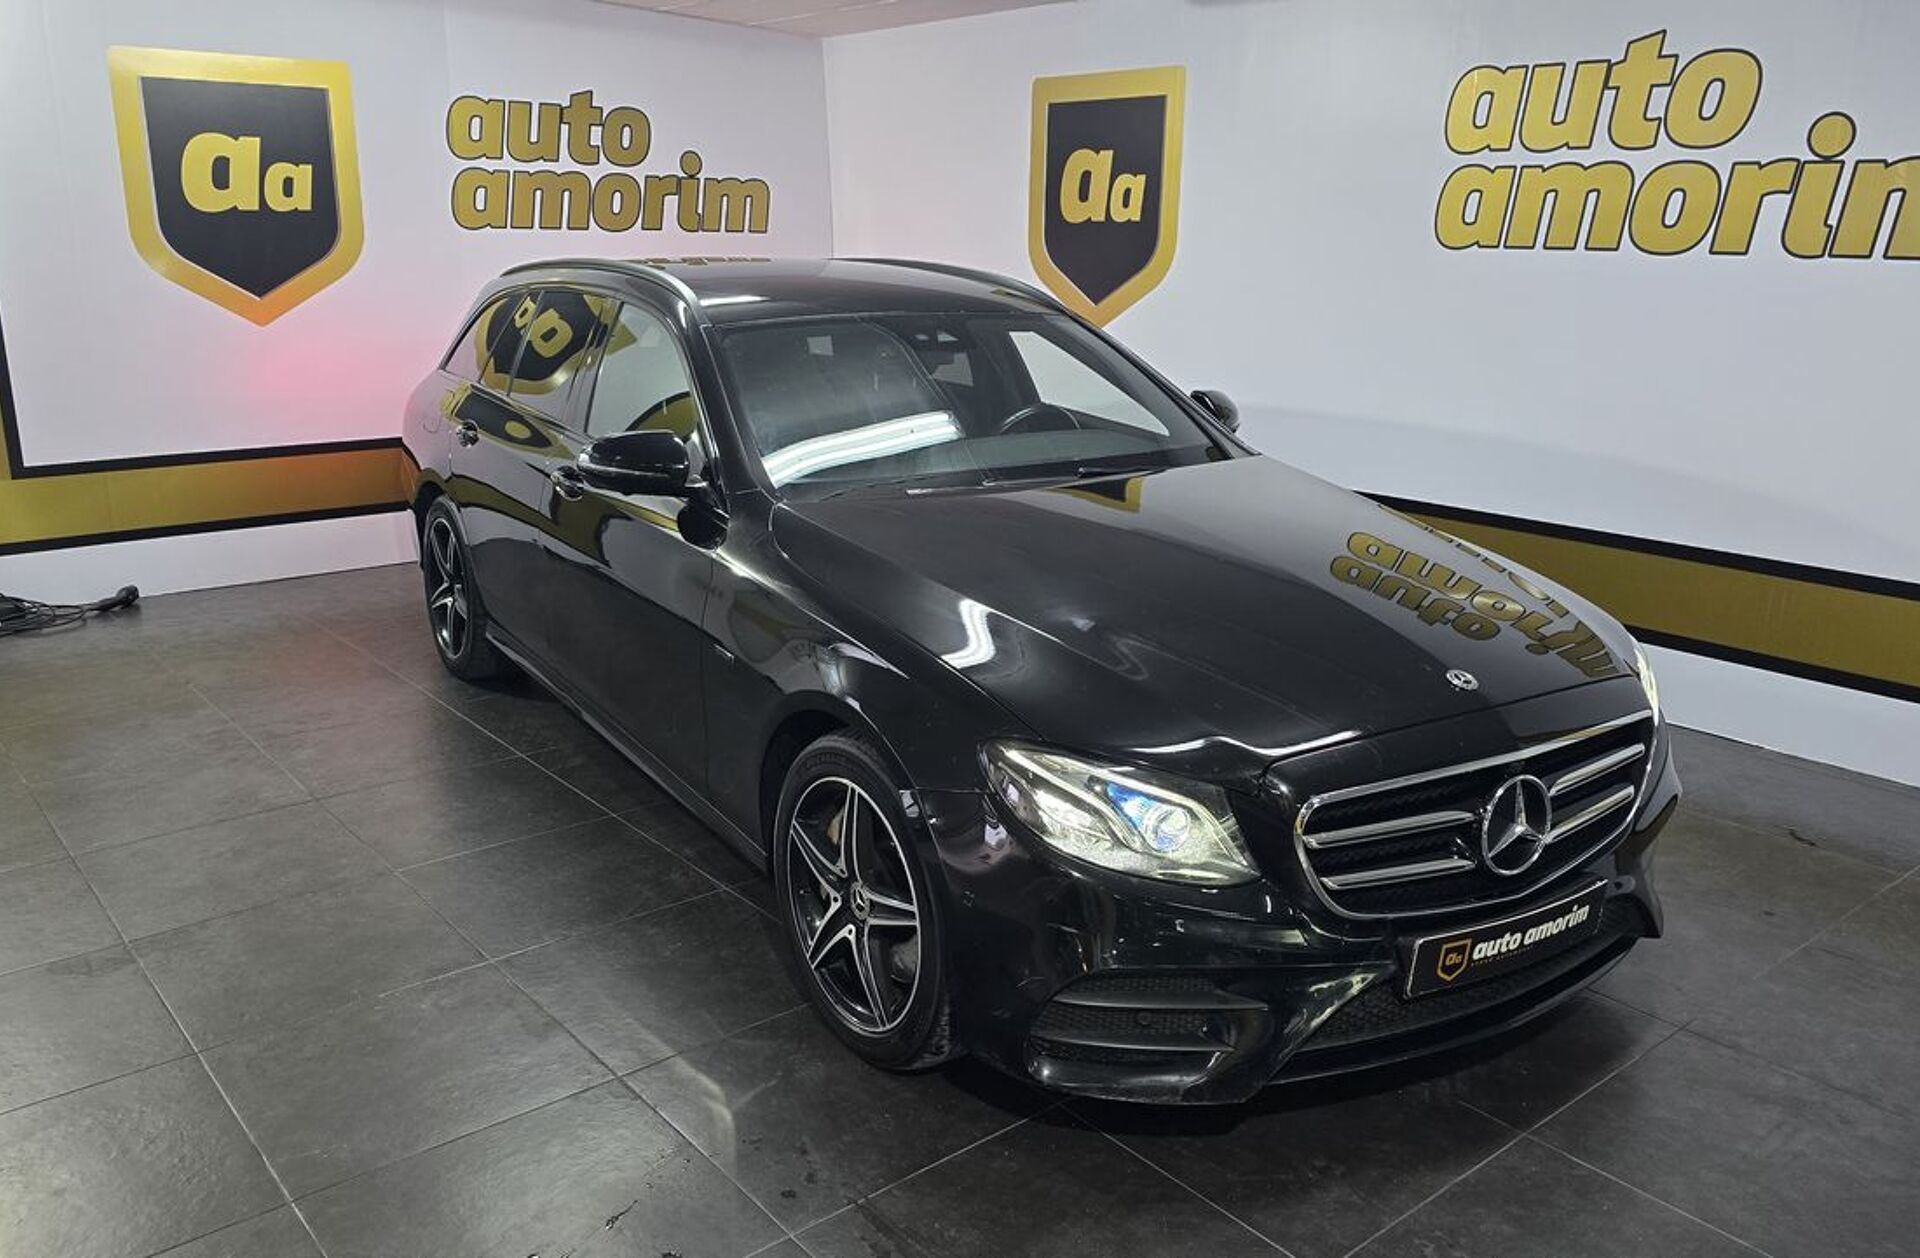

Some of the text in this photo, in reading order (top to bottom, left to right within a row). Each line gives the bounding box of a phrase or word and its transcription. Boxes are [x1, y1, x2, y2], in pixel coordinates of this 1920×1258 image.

[446, 90, 651, 166] auto
[1445, 28, 1763, 155] auto
[451, 150, 770, 234] amorim
[1473, 932, 1522, 960] auto
[1523, 904, 1590, 945] amorim
